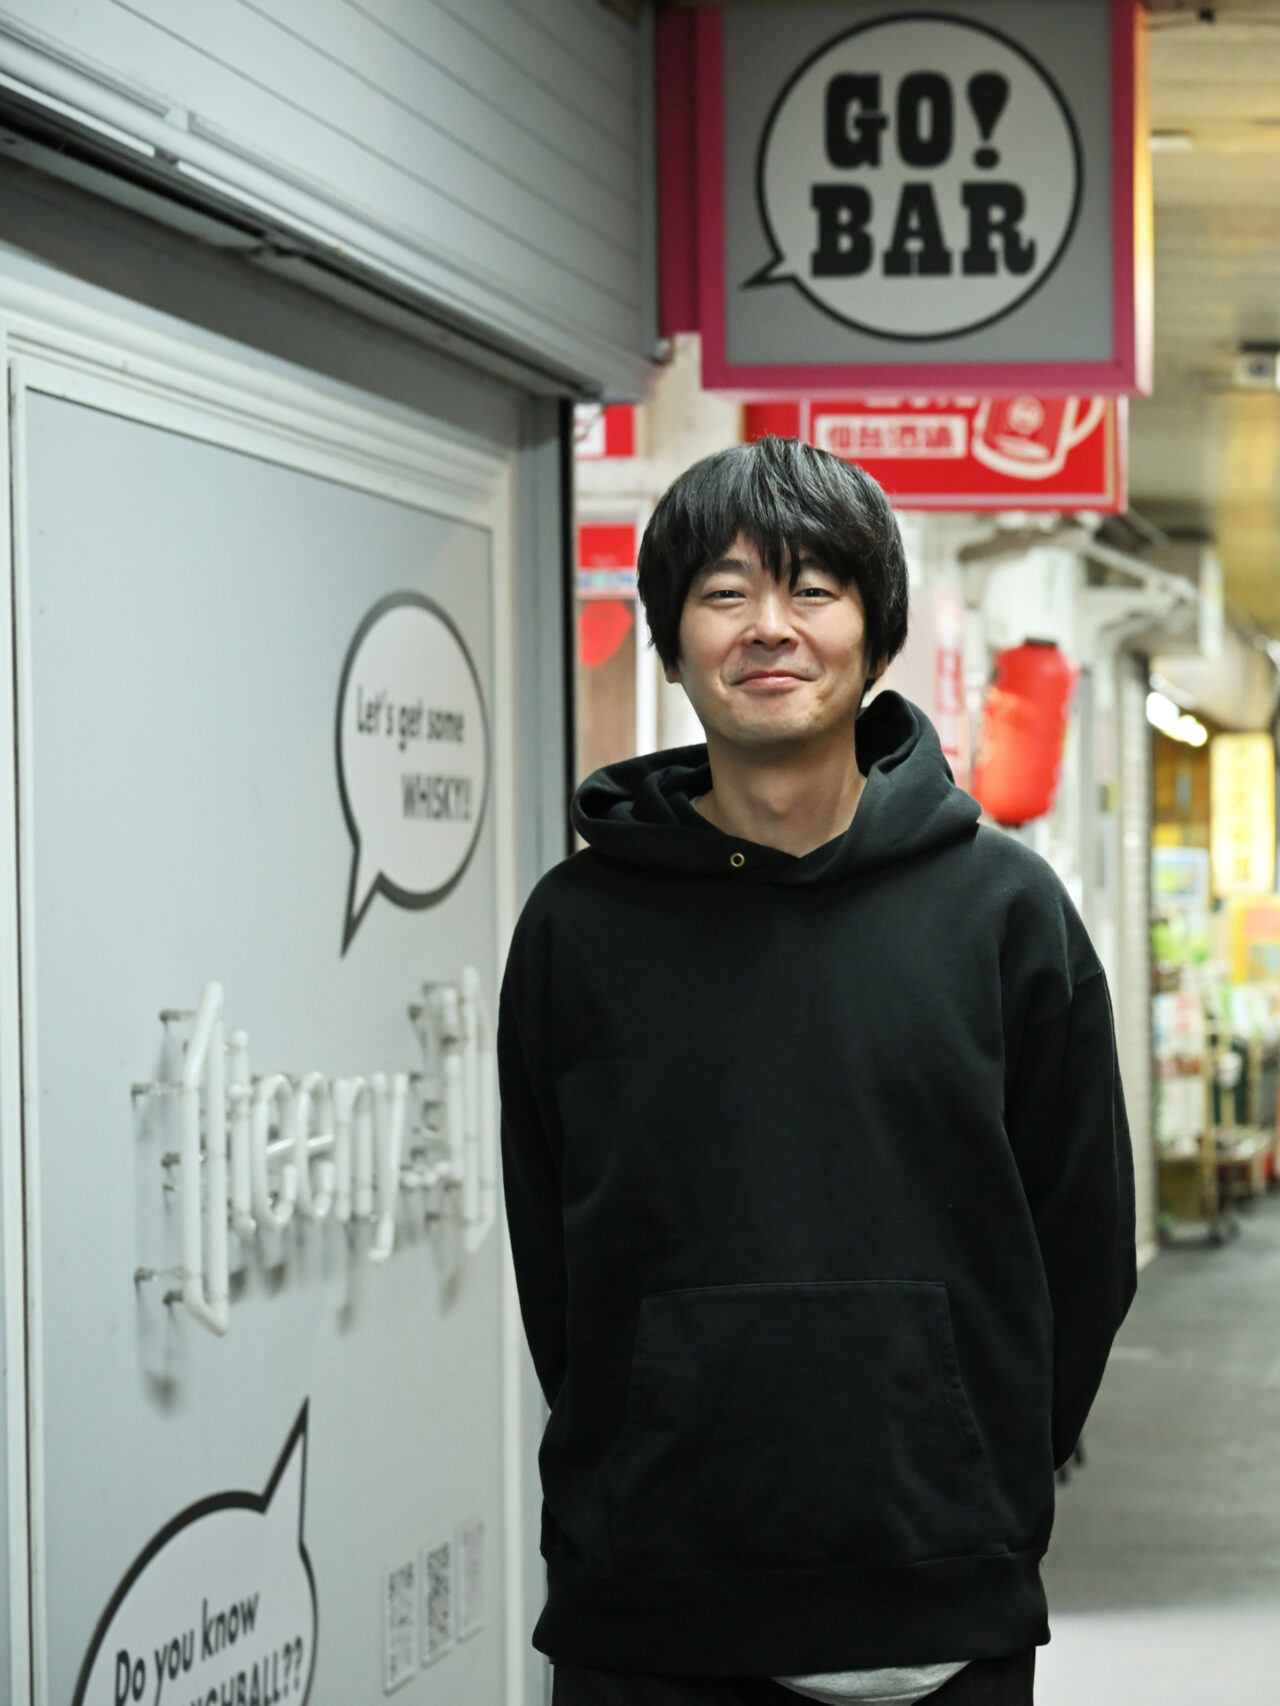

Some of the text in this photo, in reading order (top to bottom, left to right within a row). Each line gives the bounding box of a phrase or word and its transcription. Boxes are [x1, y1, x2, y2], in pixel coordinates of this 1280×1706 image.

[824, 70, 1011, 171] GO!
[810, 180, 1036, 278] BAR
[398, 697, 424, 753] get
[427, 708, 465, 743] some
[115, 1592, 260, 1706] Do you know
